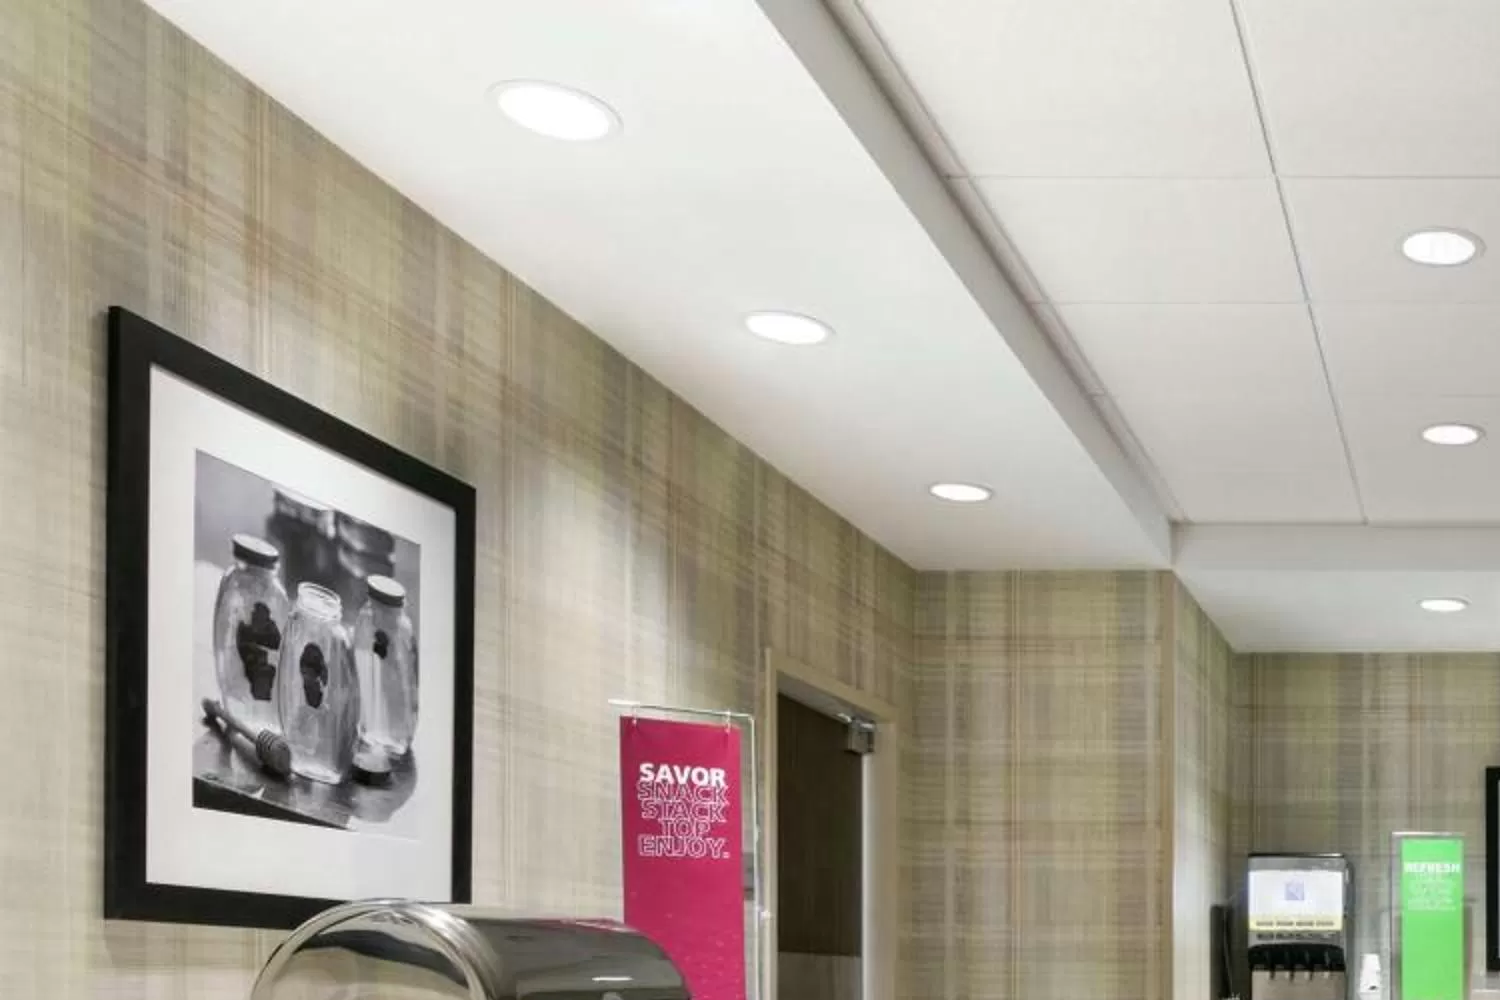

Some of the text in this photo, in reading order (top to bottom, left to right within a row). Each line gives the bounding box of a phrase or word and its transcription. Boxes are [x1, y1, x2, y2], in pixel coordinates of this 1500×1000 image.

[639, 762, 726, 787] SAVOR
[637, 780, 729, 804] SNACK
[641, 799, 727, 822] STACK
[658, 817, 711, 839] TOP
[637, 834, 730, 859] ENJOY.
